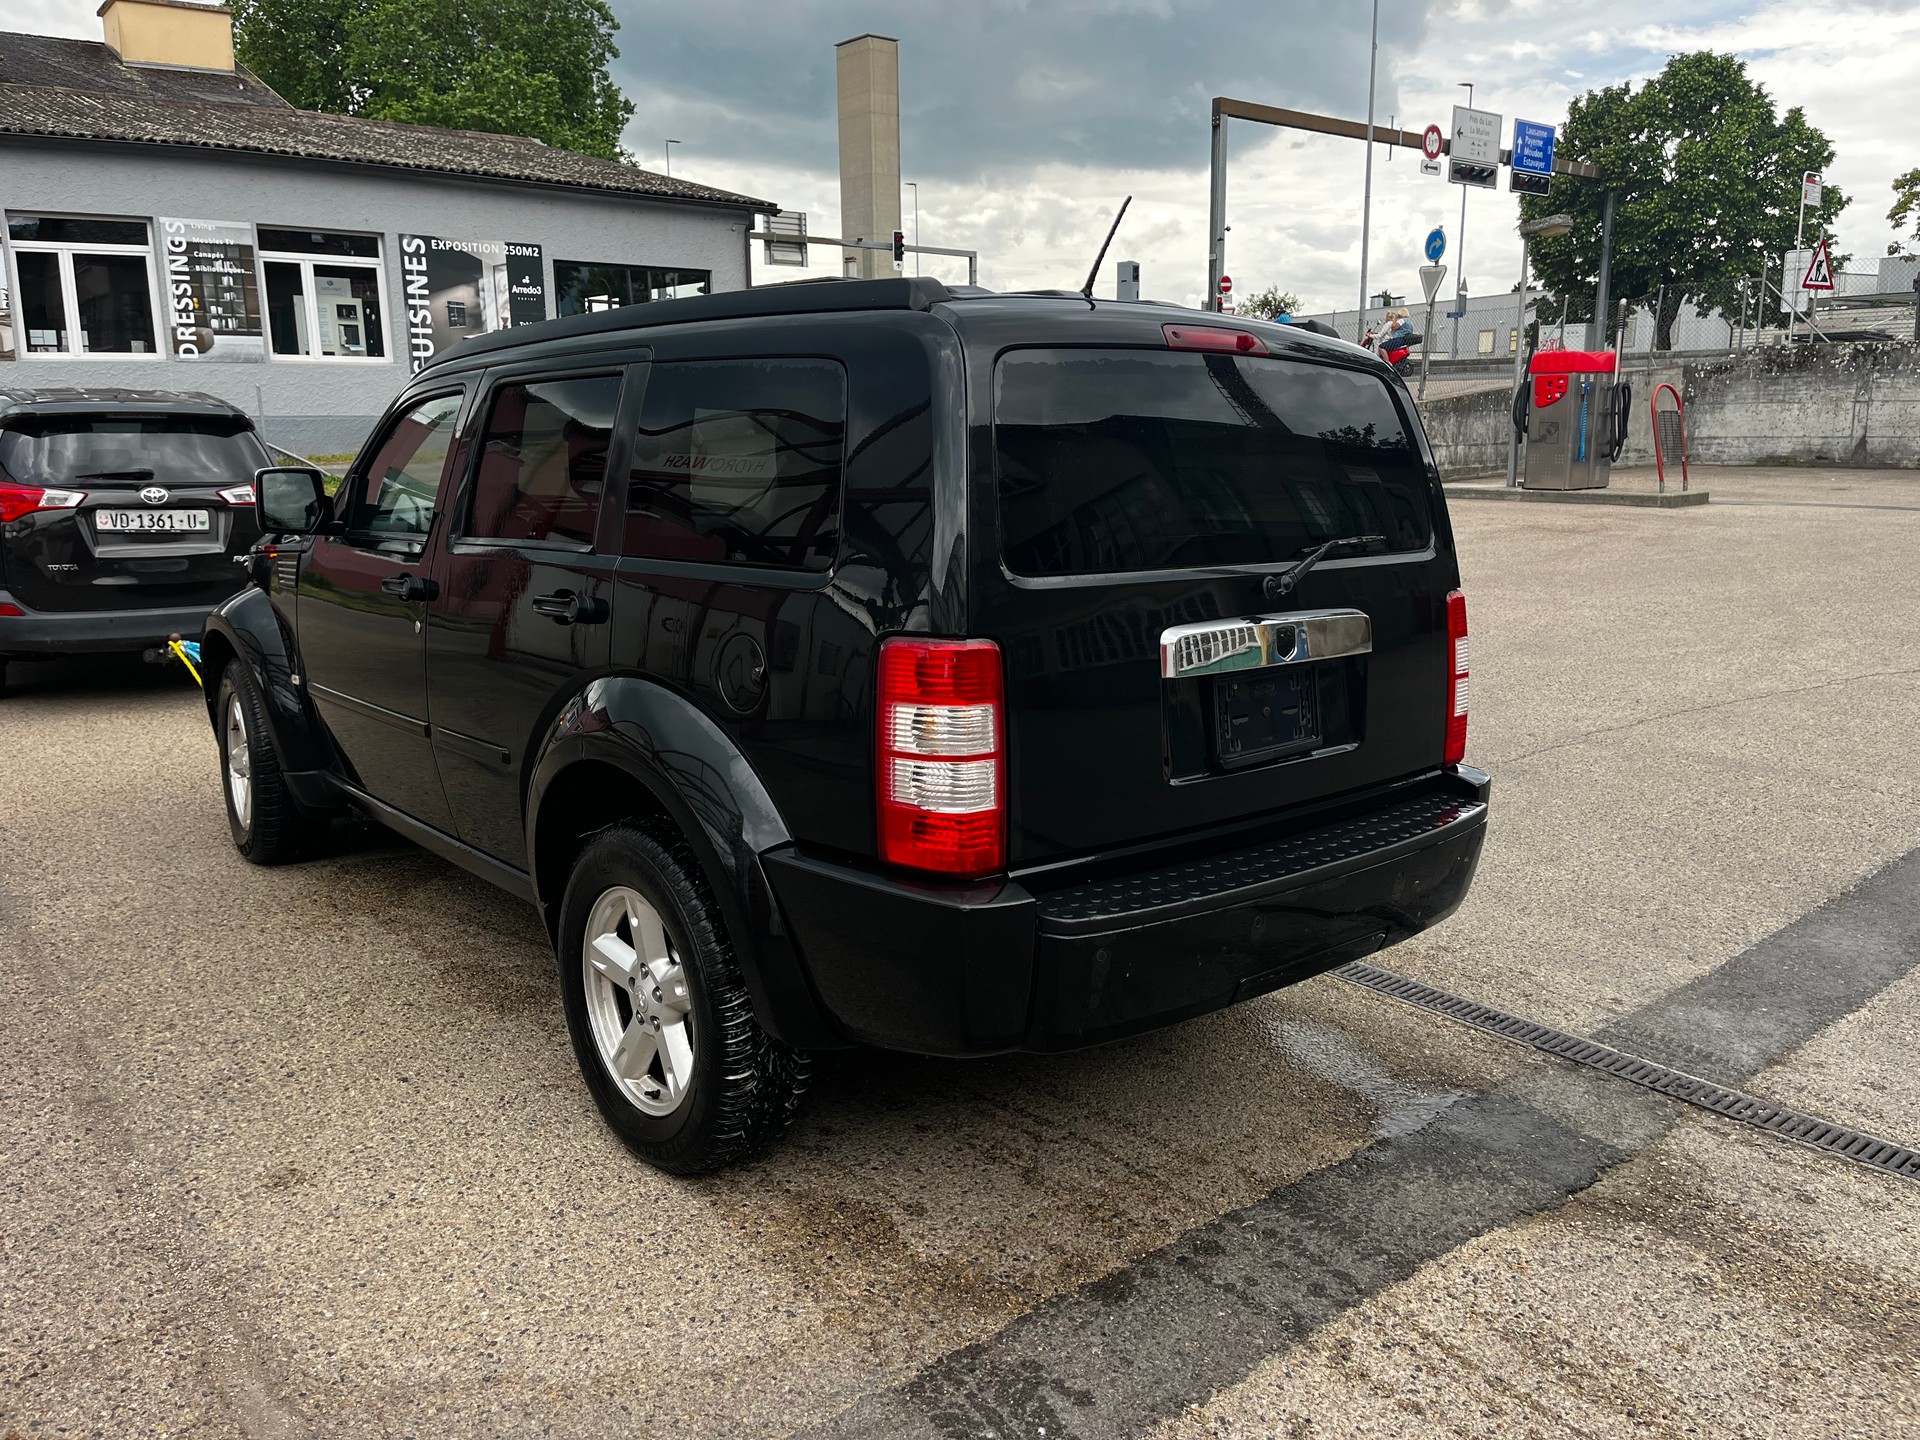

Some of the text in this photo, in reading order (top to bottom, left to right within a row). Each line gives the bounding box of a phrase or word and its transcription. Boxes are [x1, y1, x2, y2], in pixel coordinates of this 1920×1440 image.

[1526, 125, 1547, 138] Lausanne
[1525, 135, 1543, 147] Payerne
[1523, 146, 1543, 158] Moudon
[1523, 156, 1545, 170] Estavayer
[192, 236, 223, 245] Meubles
[431, 239, 539, 257] EXPOSITION 250M2
[193, 251, 224, 259] Canapés
[166, 221, 199, 359] DRESSINGS
[511, 284, 542, 295] Arredo3
